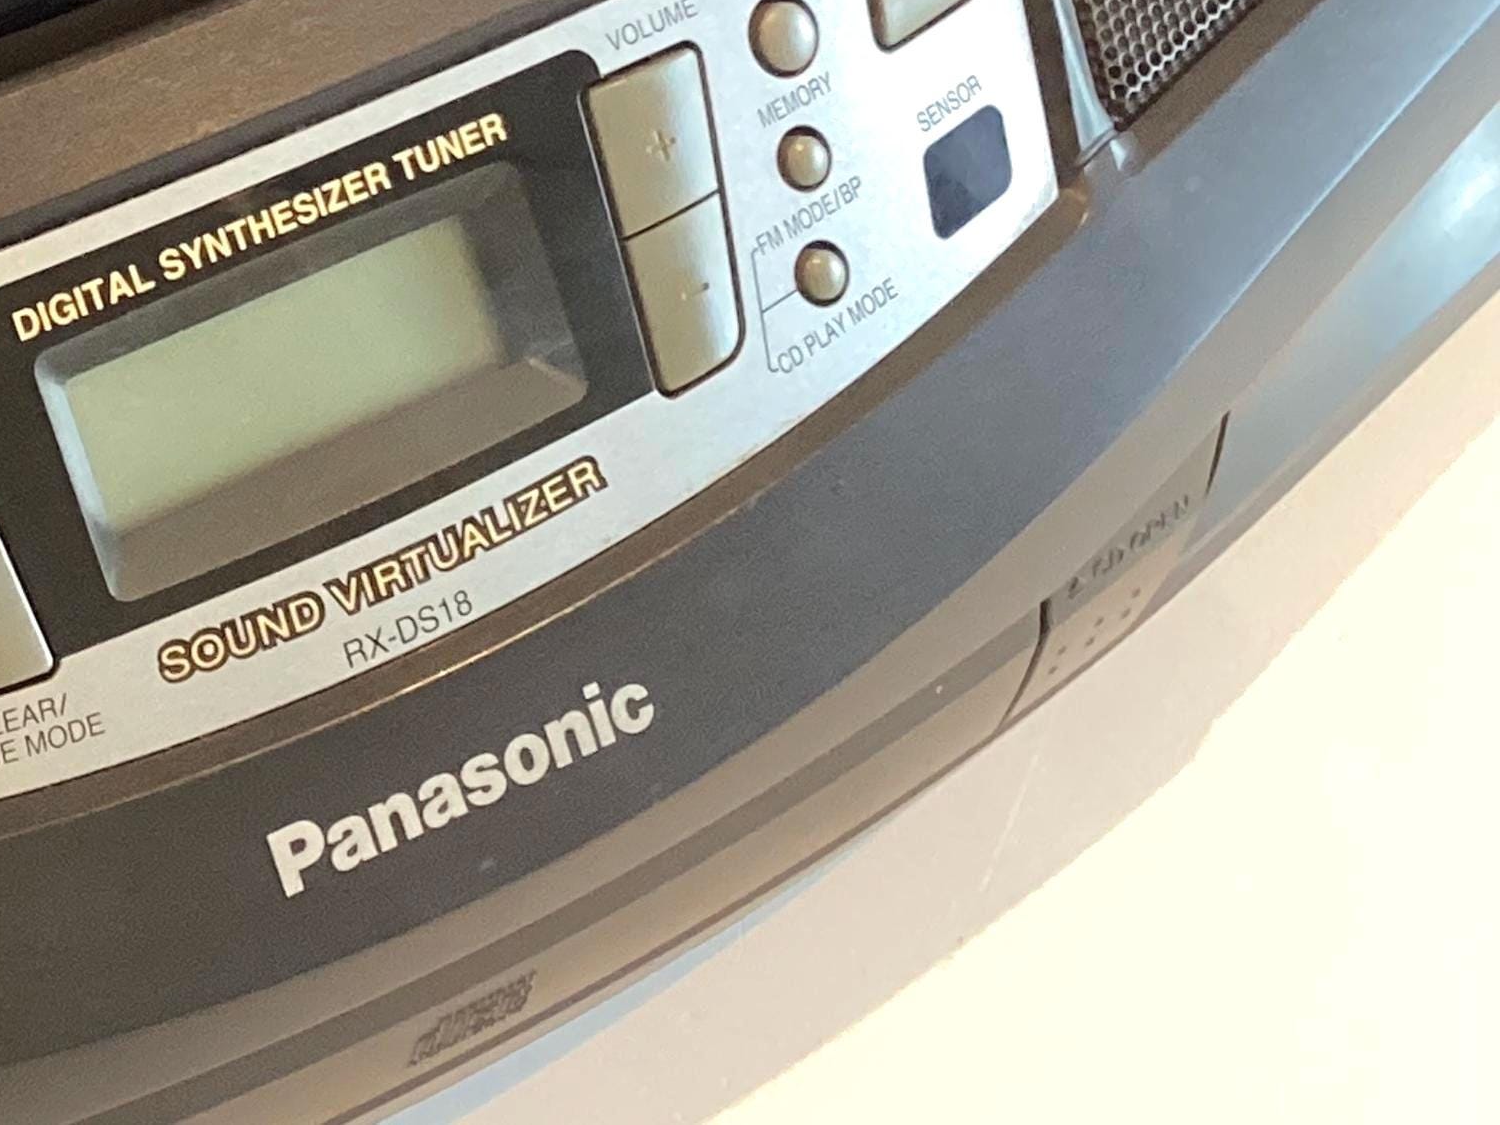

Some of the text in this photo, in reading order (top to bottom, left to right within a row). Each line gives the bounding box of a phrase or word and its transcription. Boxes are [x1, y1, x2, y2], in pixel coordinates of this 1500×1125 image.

[757, 71, 833, 129] MEMORY
[916, 75, 983, 133] SENSOR
[11, 112, 508, 342] DIGITAL SYNTHESIZER TUNER
[756, 175, 863, 256] FM MODE/BP
[776, 277, 899, 374] CD PLAY MODE
[158, 455, 608, 684] SOUND VIRTUALIZER
[343, 589, 474, 669] RX-DS18
[25, 712, 106, 759] MODE
[266, 681, 655, 899] Panasonic
